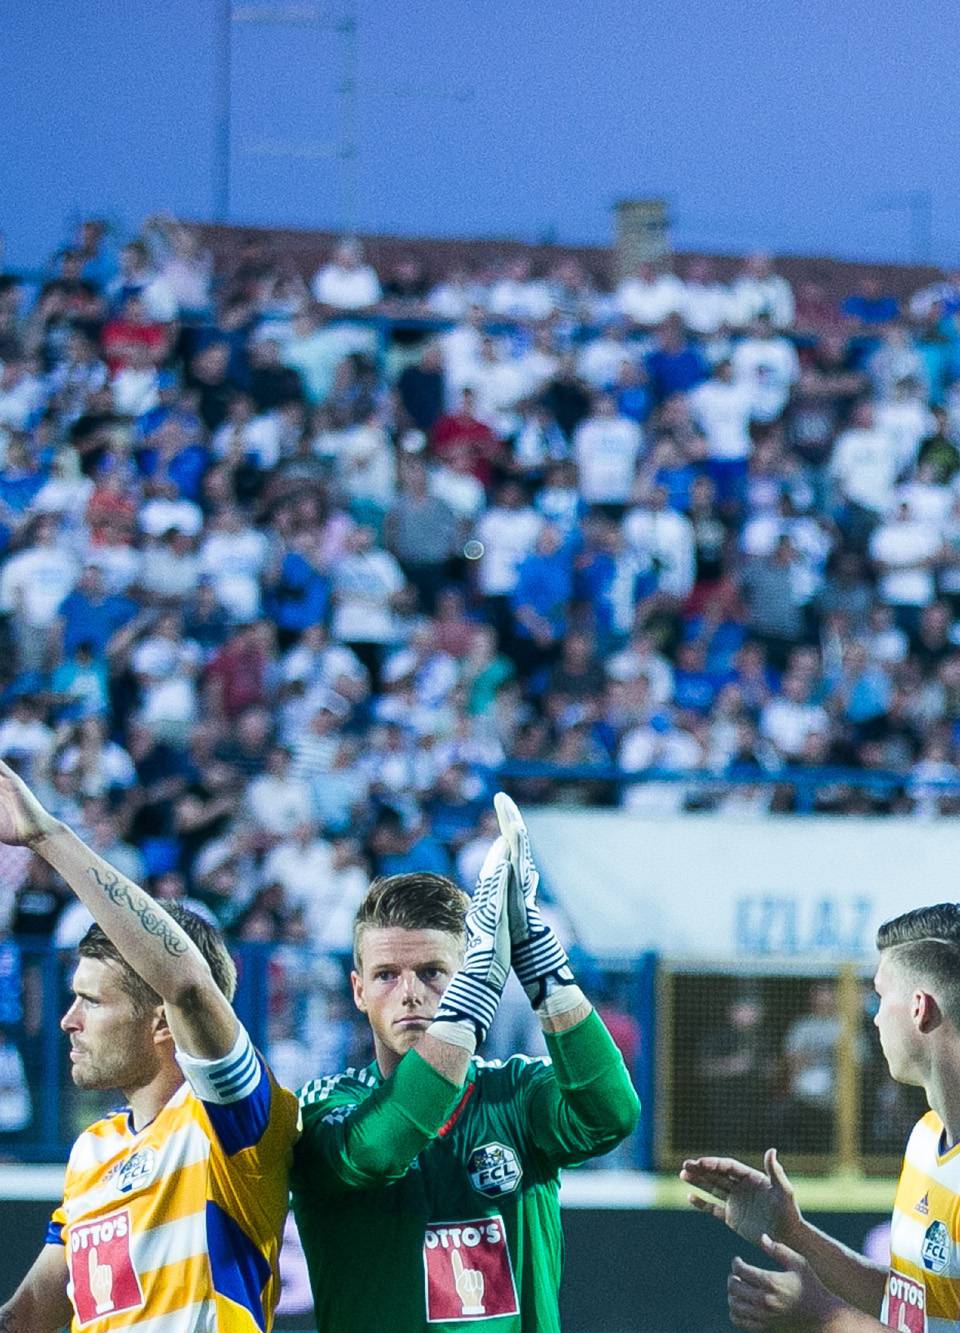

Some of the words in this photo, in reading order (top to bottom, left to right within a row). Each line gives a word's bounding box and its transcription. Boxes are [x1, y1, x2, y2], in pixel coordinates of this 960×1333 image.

[479, 1164, 516, 1184] FCL
[70, 1214, 128, 1242] OTTO'S
[424, 1223, 499, 1249] OTTO'S
[925, 1245, 946, 1261] FCL
[888, 1274, 925, 1301] OTTO'S
